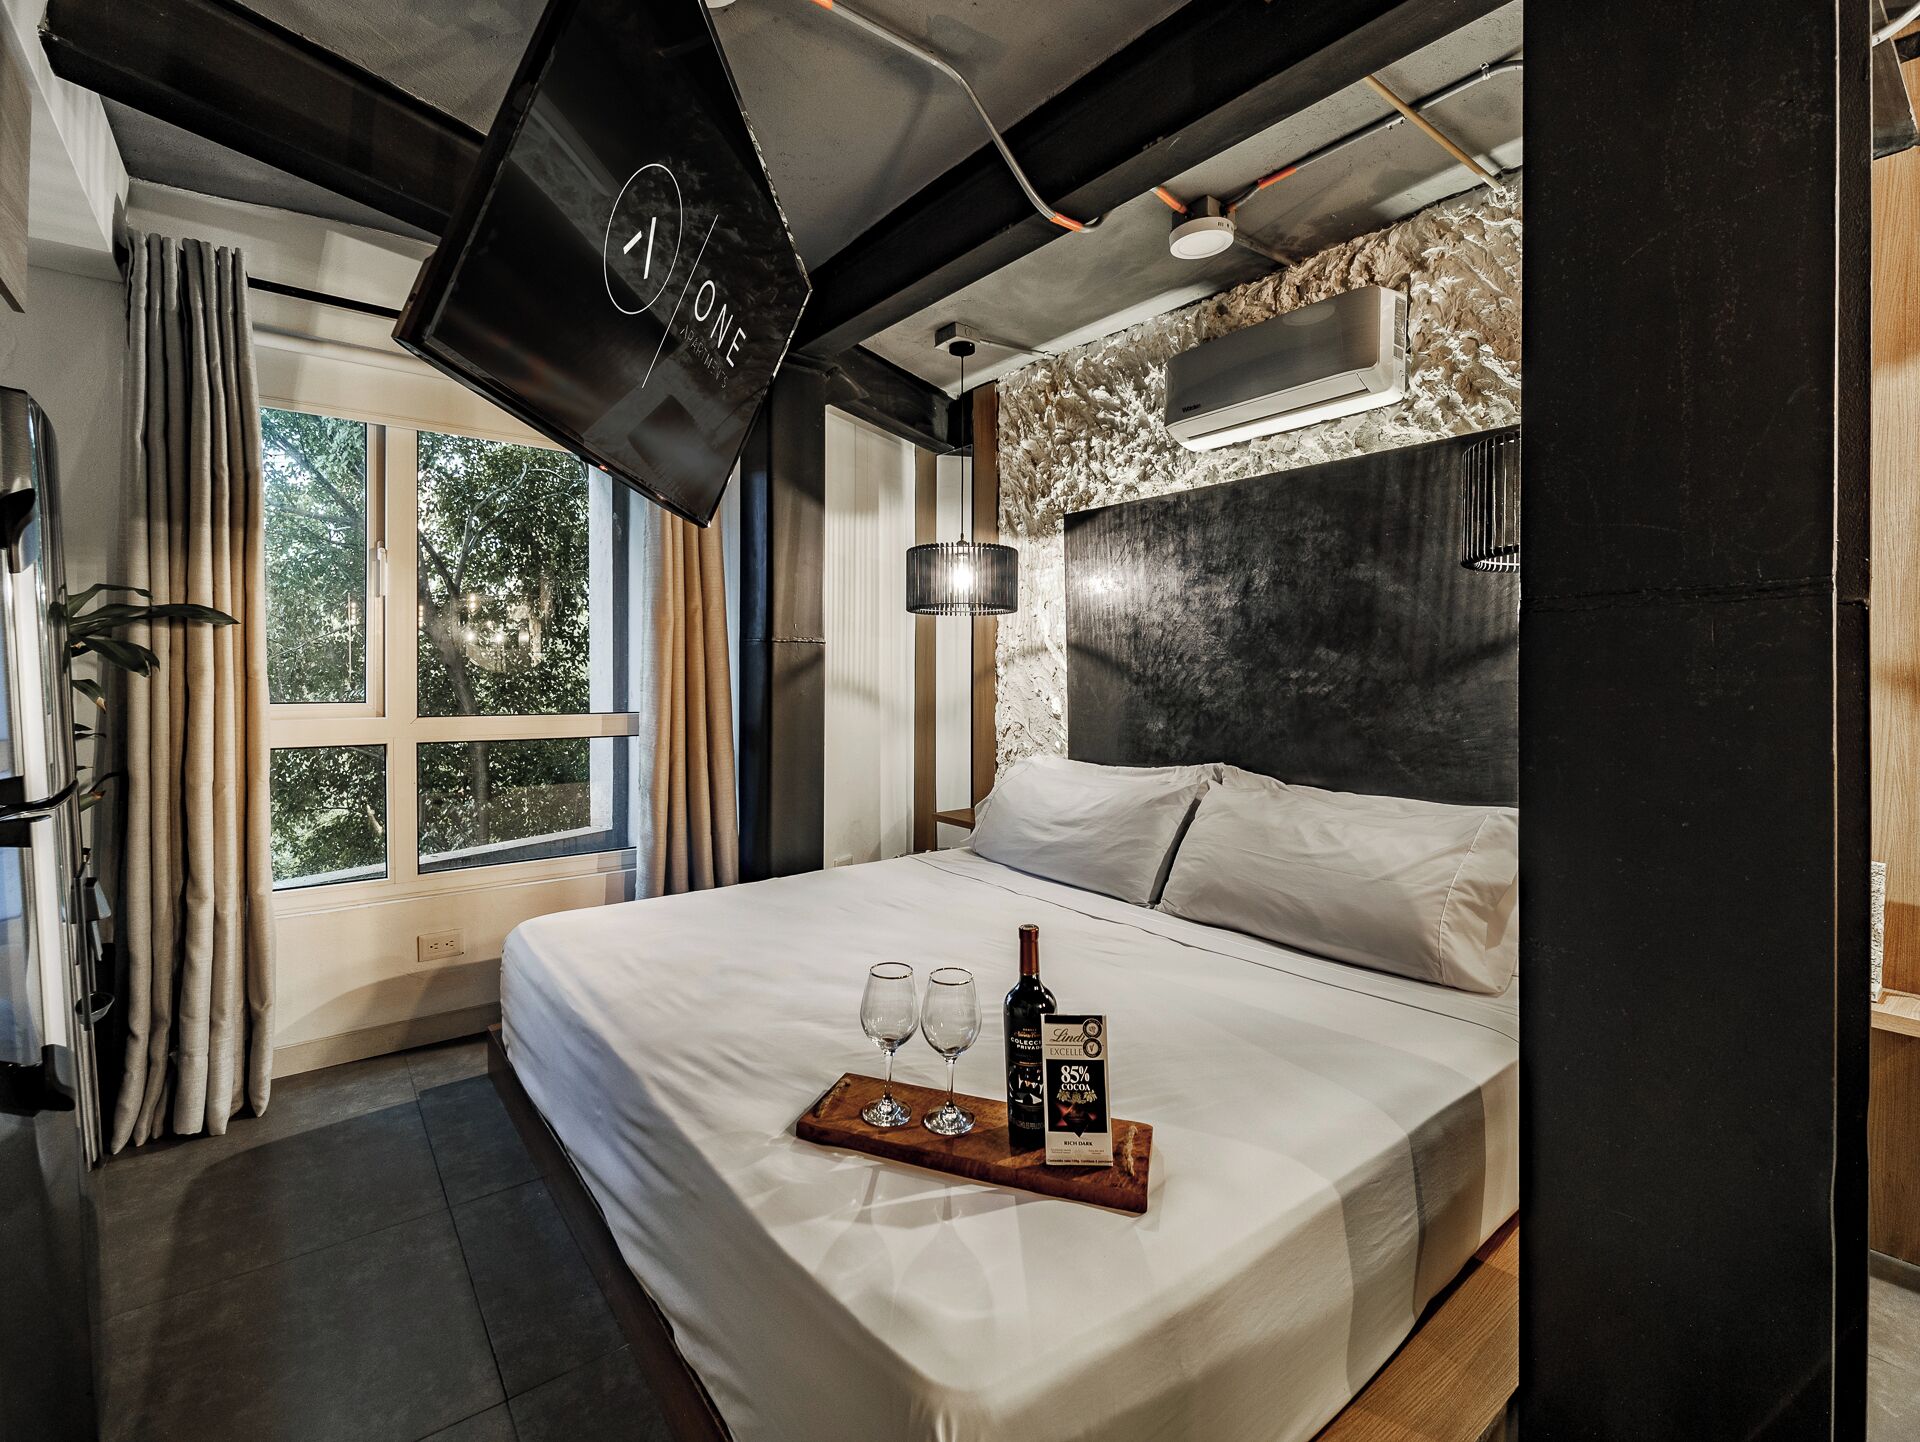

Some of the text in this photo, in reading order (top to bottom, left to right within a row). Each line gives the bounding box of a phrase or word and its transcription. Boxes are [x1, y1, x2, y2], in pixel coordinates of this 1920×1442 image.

[694, 279, 747, 368] ONE
[679, 323, 729, 389] APARTMENTS
[1010, 1036, 1042, 1046] COLECCI
[1049, 1047, 1085, 1056] EXCELLE
[1060, 1064, 1090, 1084] 85%
[1060, 1083, 1091, 1091] COCOA
